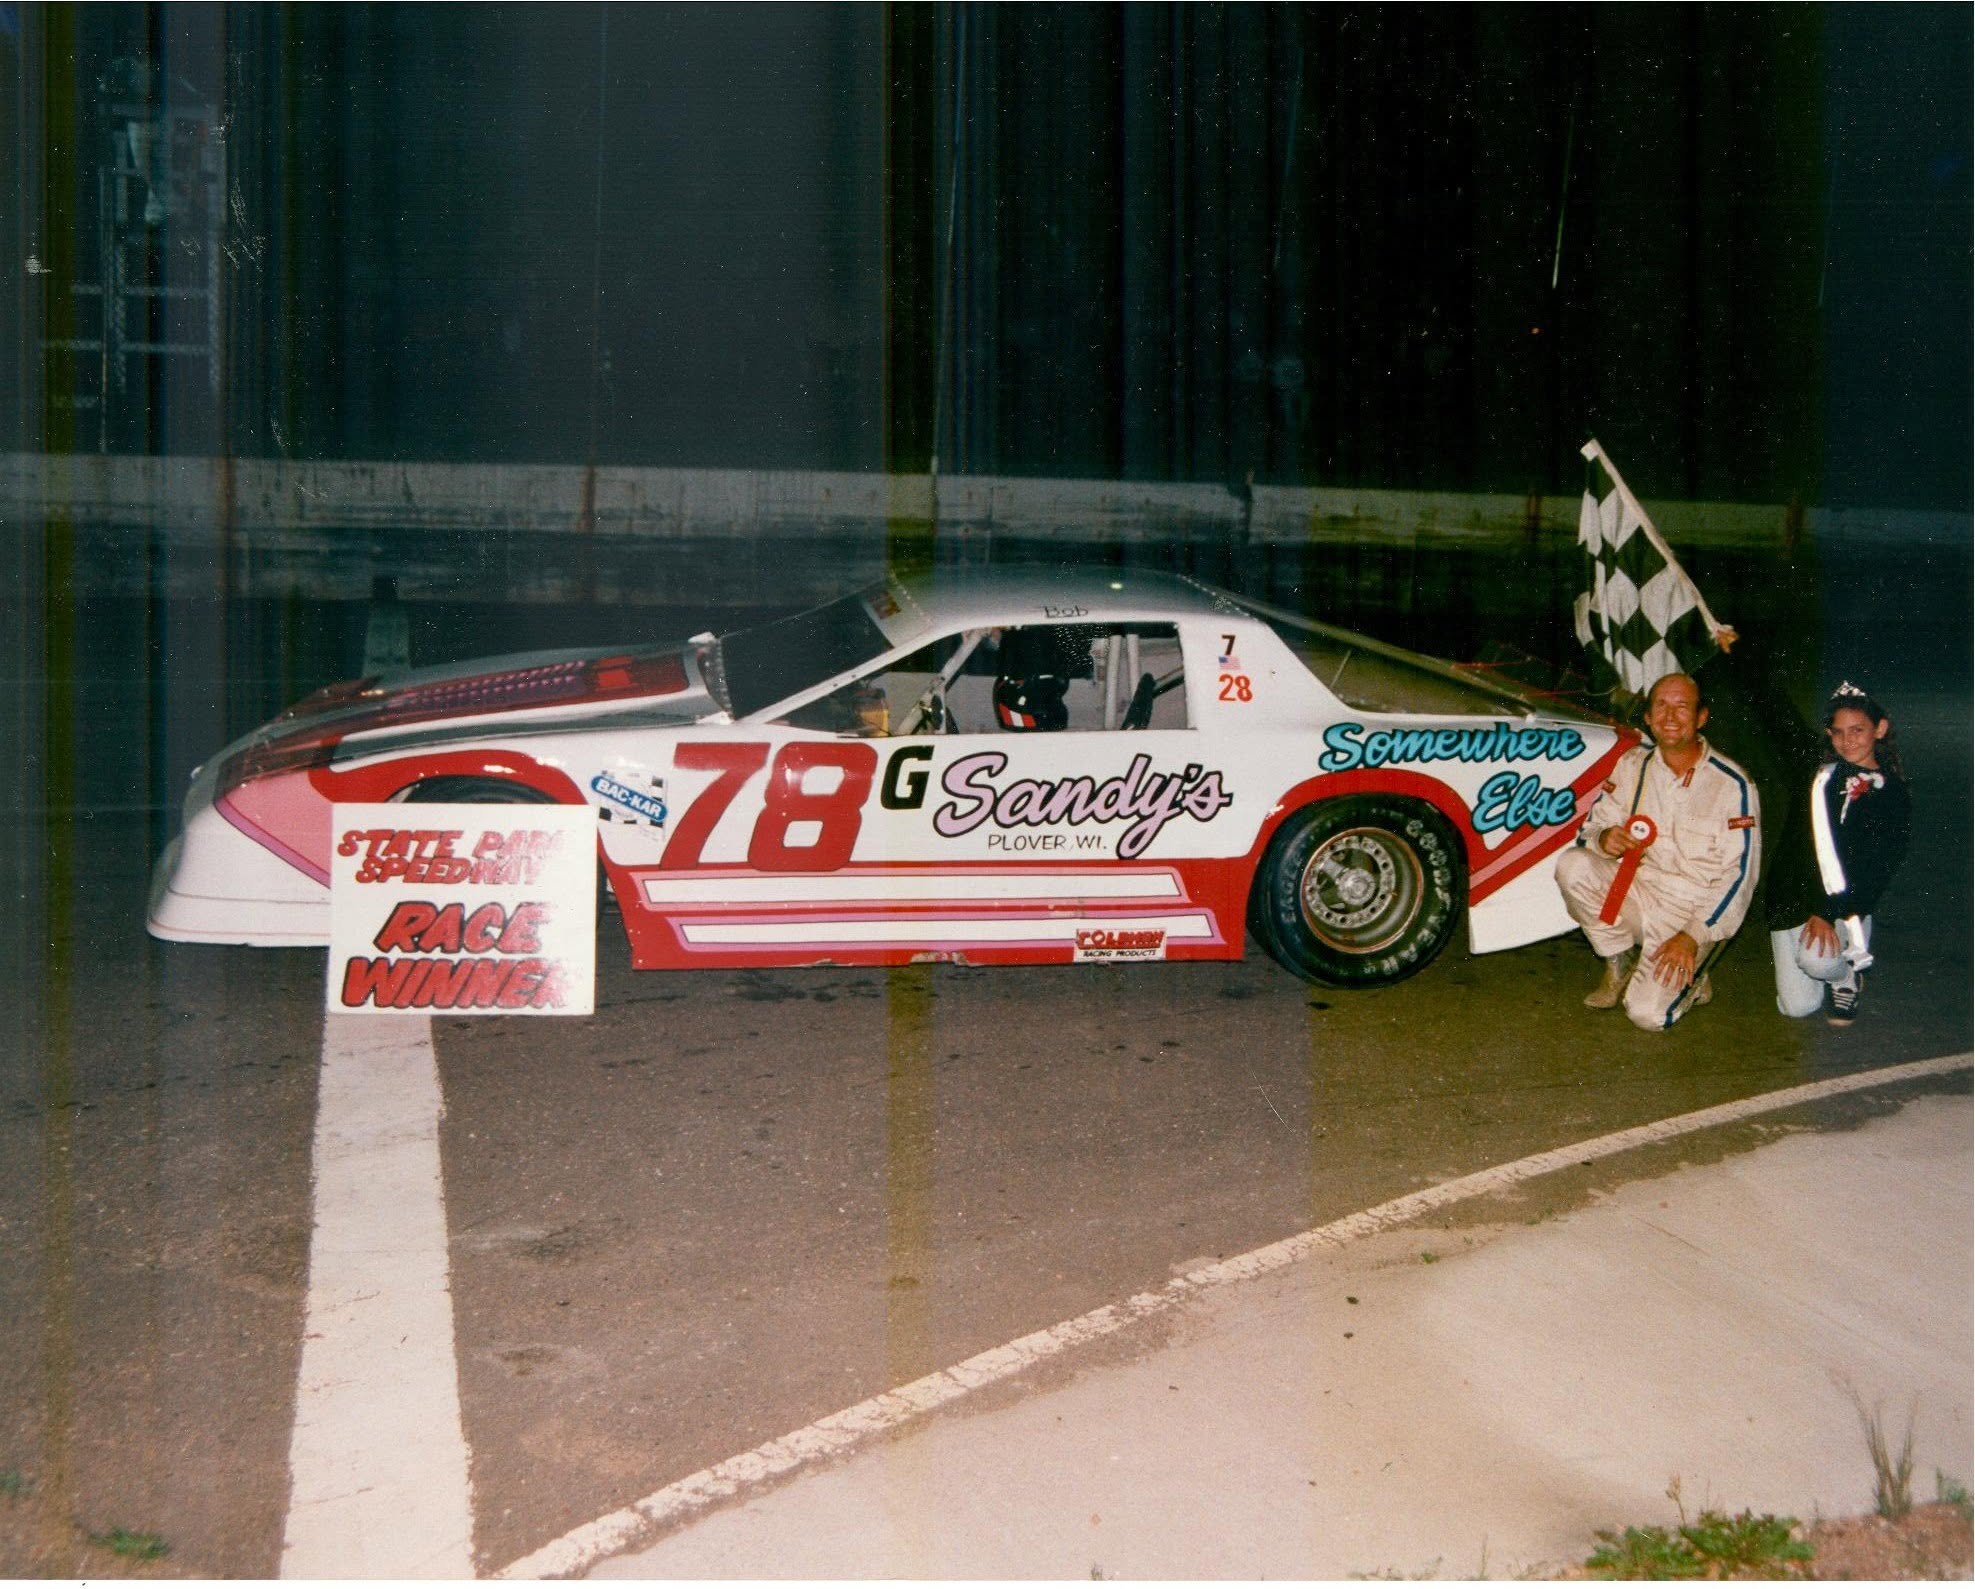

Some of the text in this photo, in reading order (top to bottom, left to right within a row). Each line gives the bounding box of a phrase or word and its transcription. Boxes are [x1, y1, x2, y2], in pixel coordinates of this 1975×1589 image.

[1043, 604, 1089, 619] Bob
[1221, 634, 1236, 656] 7
[1218, 673, 1253, 702] 28
[1318, 721, 1586, 772] Somewhere
[595, 777, 663, 818] BAC-KAR
[659, 741, 935, 872] 78 G
[933, 751, 1234, 860] Sandy's
[1471, 771, 1577, 835] Else
[337, 829, 464, 857] STATE
[1076, 834, 1107, 850] WI.
[356, 856, 543, 885] SPEEDWAY
[373, 900, 556, 953] RACE
[341, 956, 571, 1009] WINNER
